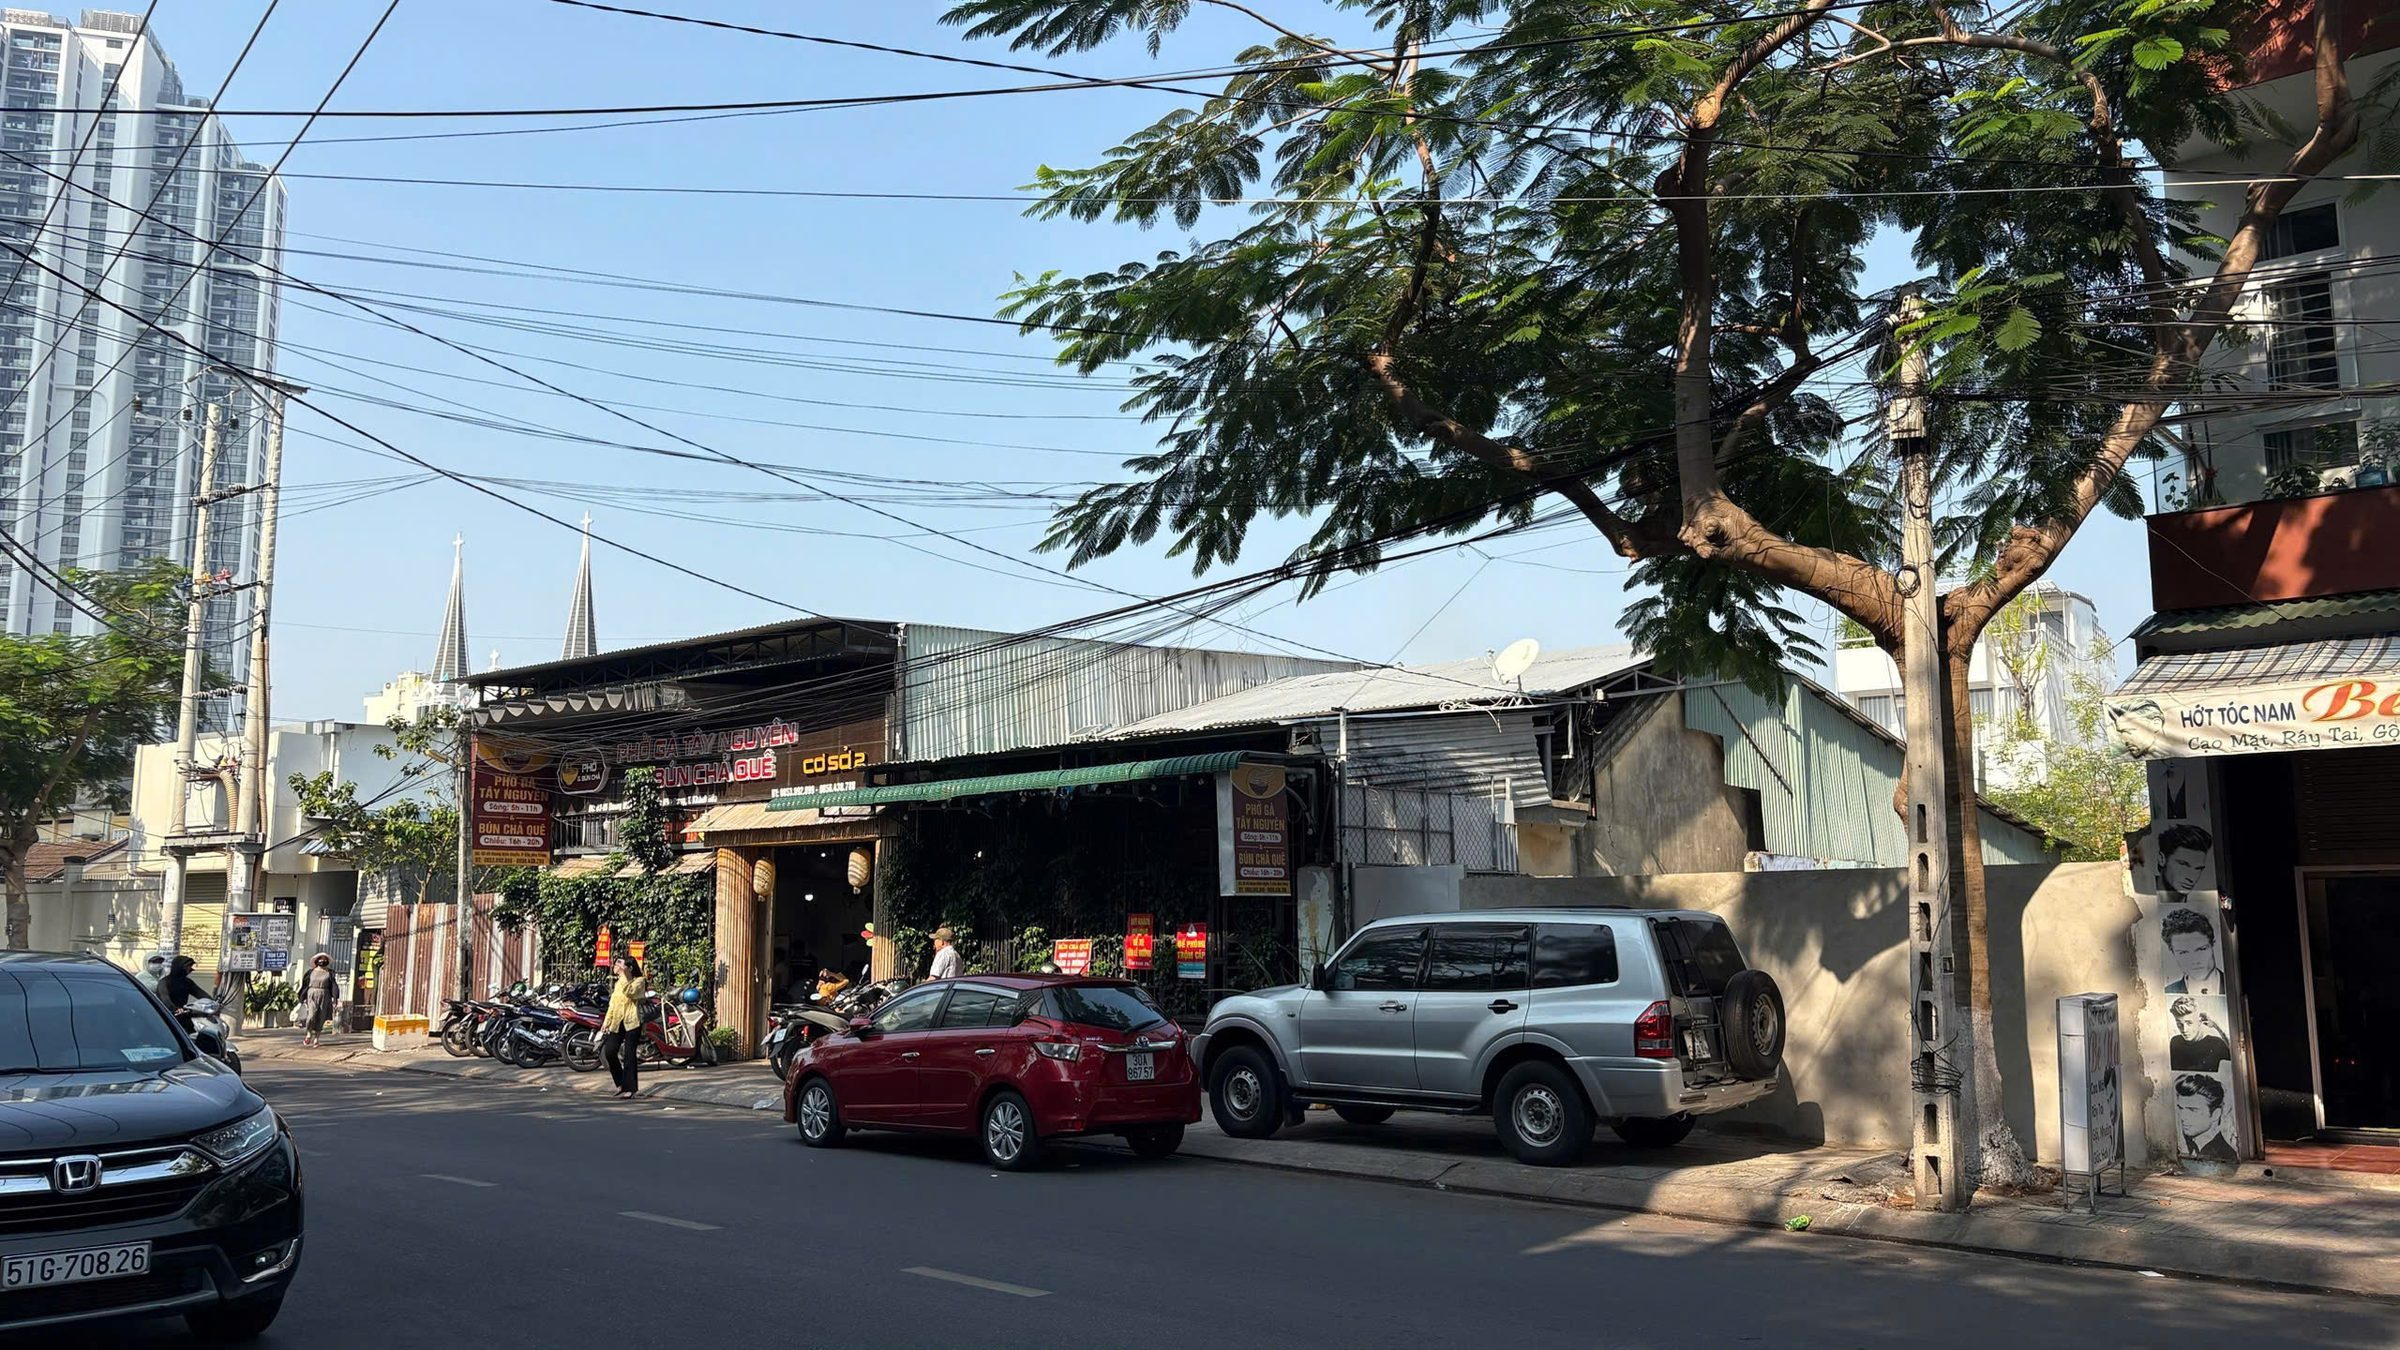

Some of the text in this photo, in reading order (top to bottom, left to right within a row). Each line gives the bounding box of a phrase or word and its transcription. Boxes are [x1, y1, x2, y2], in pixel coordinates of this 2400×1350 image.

[2181, 701, 2296, 728] HỚT TÓC NAM
[617, 717, 799, 763] PHỞ GÀ TÂY NGUYÊN
[2188, 736, 2222, 753] Cạo
[2231, 733, 2274, 750] Mặt,
[854, 752, 866, 767] 2
[655, 748, 777, 788] BÚN CHẢ QUÊ
[494, 774, 518, 788] PHỞ
[480, 786, 549, 801] TÂY NGUYÊN
[526, 803, 538, 812] 11h
[1245, 800, 1275, 816] PHỞ GÀ
[479, 820, 546, 835] BÚN CHẢ QUÊ
[1236, 815, 1285, 831] TÂY NGUYÊN
[1238, 850, 1286, 867] BÚN CHẢ QUÊ
[1132, 1055, 1147, 1066] 30A
[7, 1247, 146, 1286] 51G-708.26
